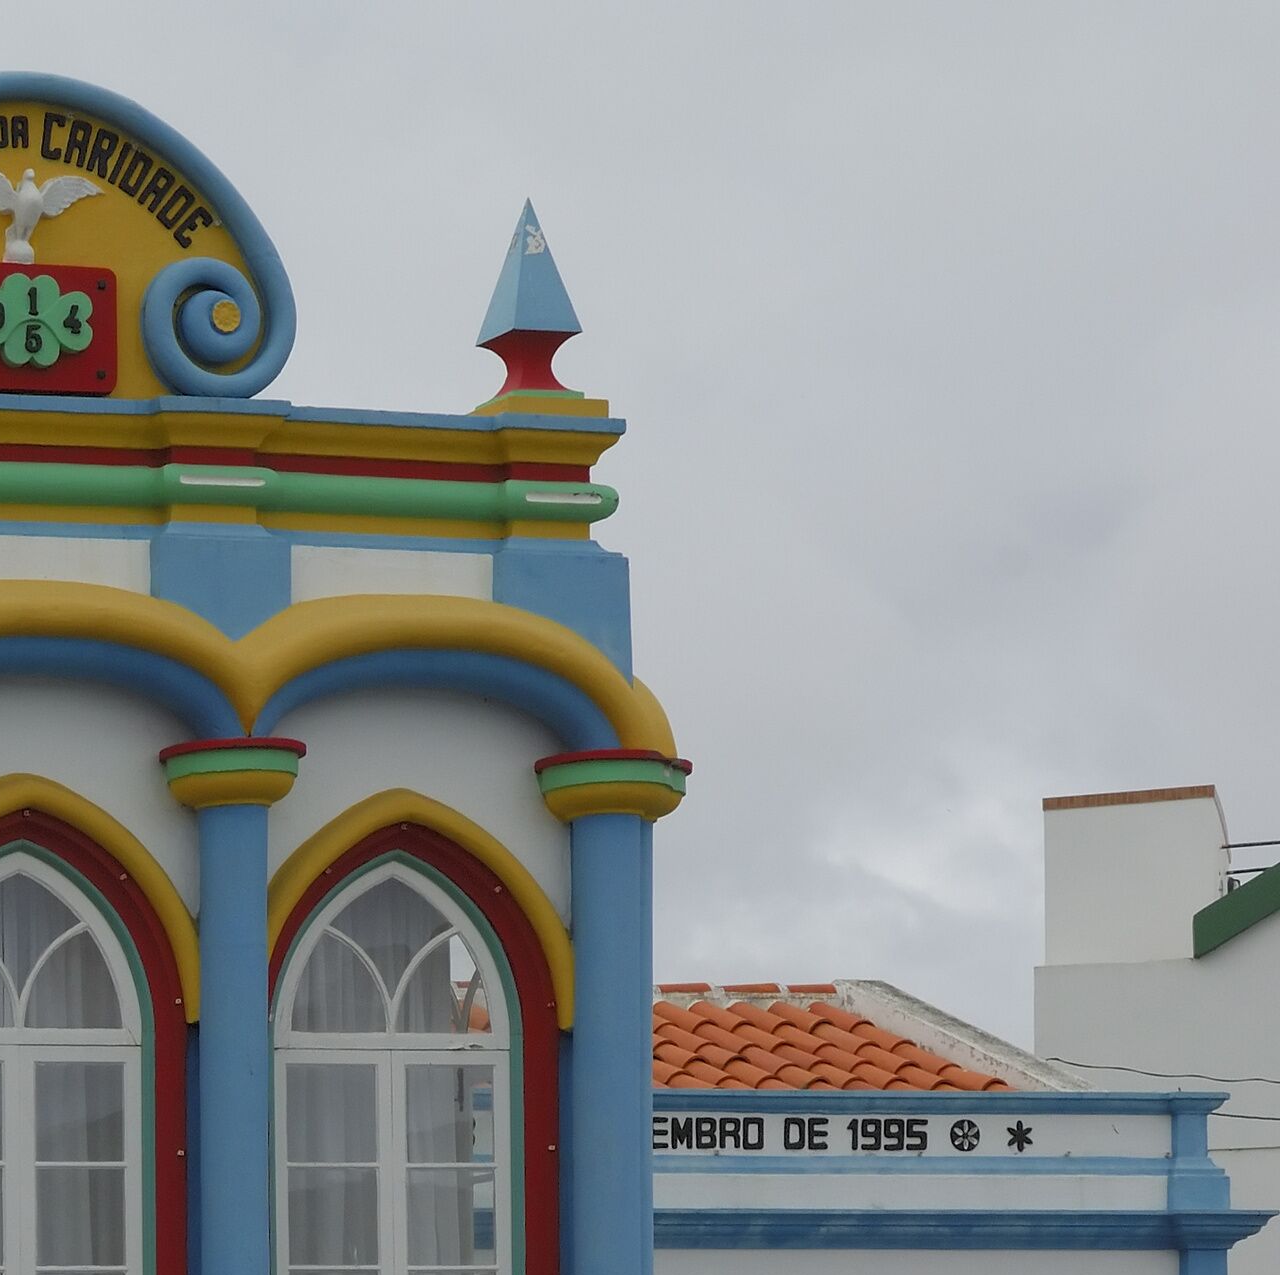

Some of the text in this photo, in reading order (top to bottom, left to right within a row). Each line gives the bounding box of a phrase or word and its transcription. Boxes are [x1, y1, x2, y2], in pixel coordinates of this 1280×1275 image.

[41, 112, 214, 249] CARIDADE
[27, 286, 39, 316] 1
[63, 304, 82, 335] 4
[25, 324, 43, 354] 5
[783, 1116, 830, 1151] DE
[846, 1117, 929, 1152] 1995
